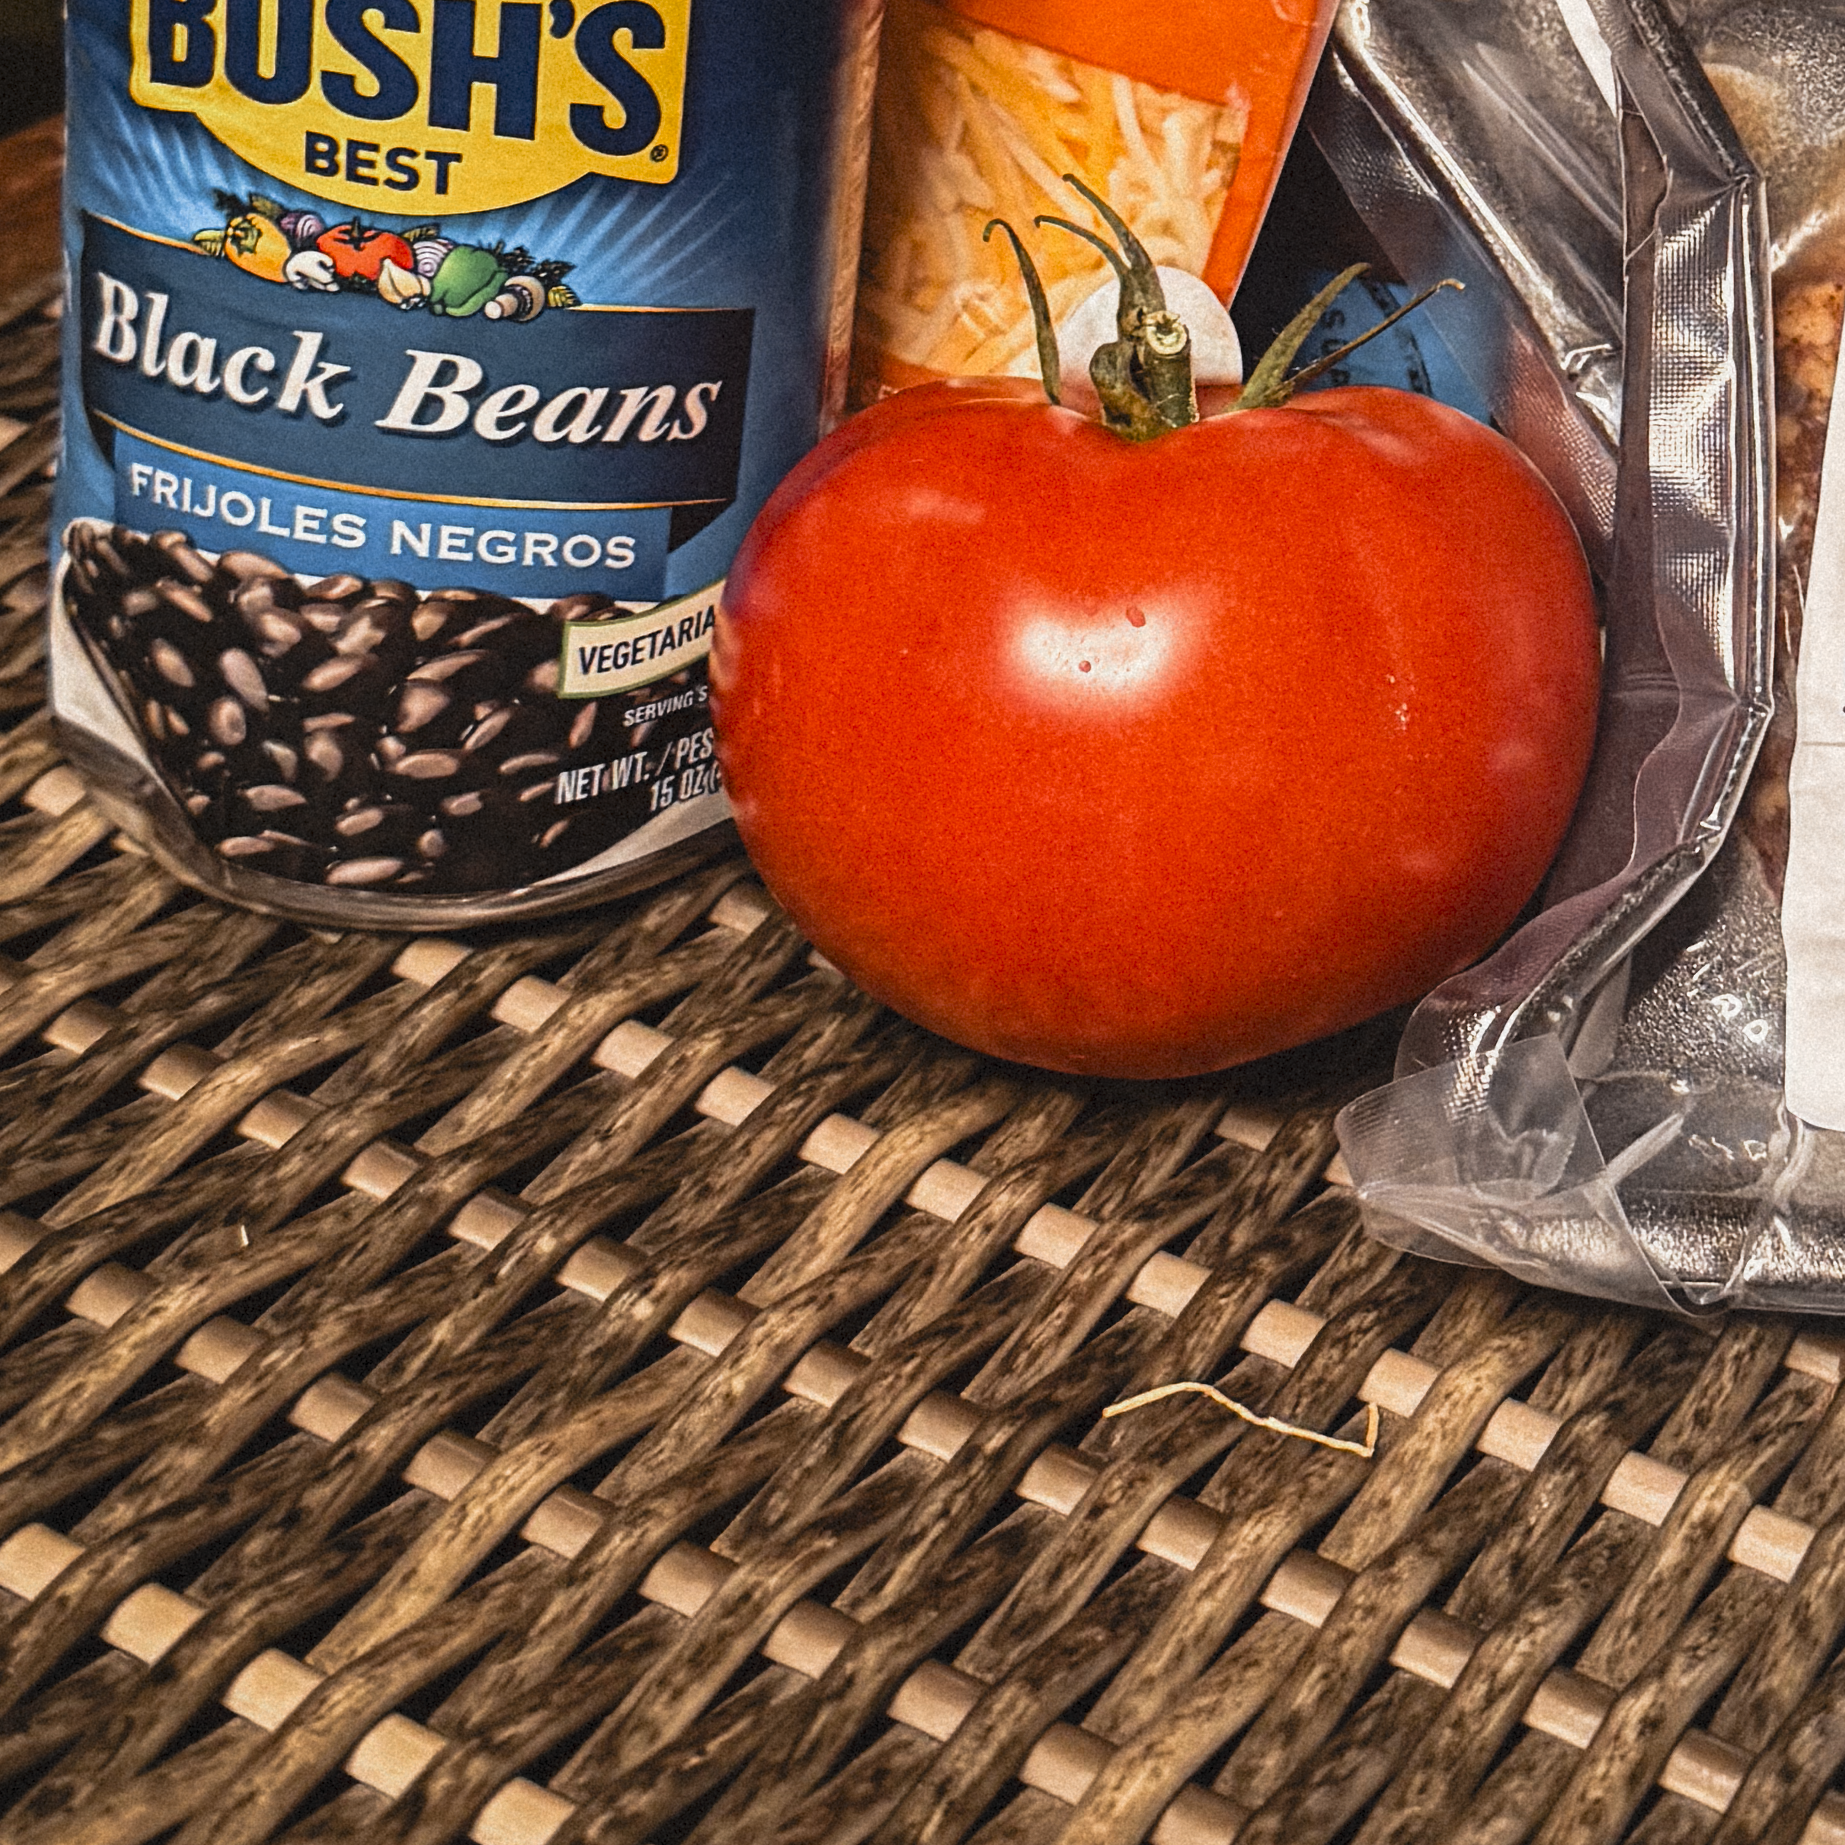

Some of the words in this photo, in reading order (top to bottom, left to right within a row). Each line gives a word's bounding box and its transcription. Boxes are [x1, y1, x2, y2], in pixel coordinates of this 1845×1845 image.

[303, 130, 463, 195] BEST
[93, 271, 354, 420] Black
[375, 349, 724, 446] Beans
[129, 462, 368, 549] FRIJOLES
[390, 520, 637, 571] NEGROS
[578, 604, 716, 676] VEGETARIA
[623, 690, 694, 727] SERVING
[554, 763, 606, 805] NET
[611, 751, 650, 790] WT.
[674, 726, 714, 772] PES
[650, 775, 676, 812] 15
